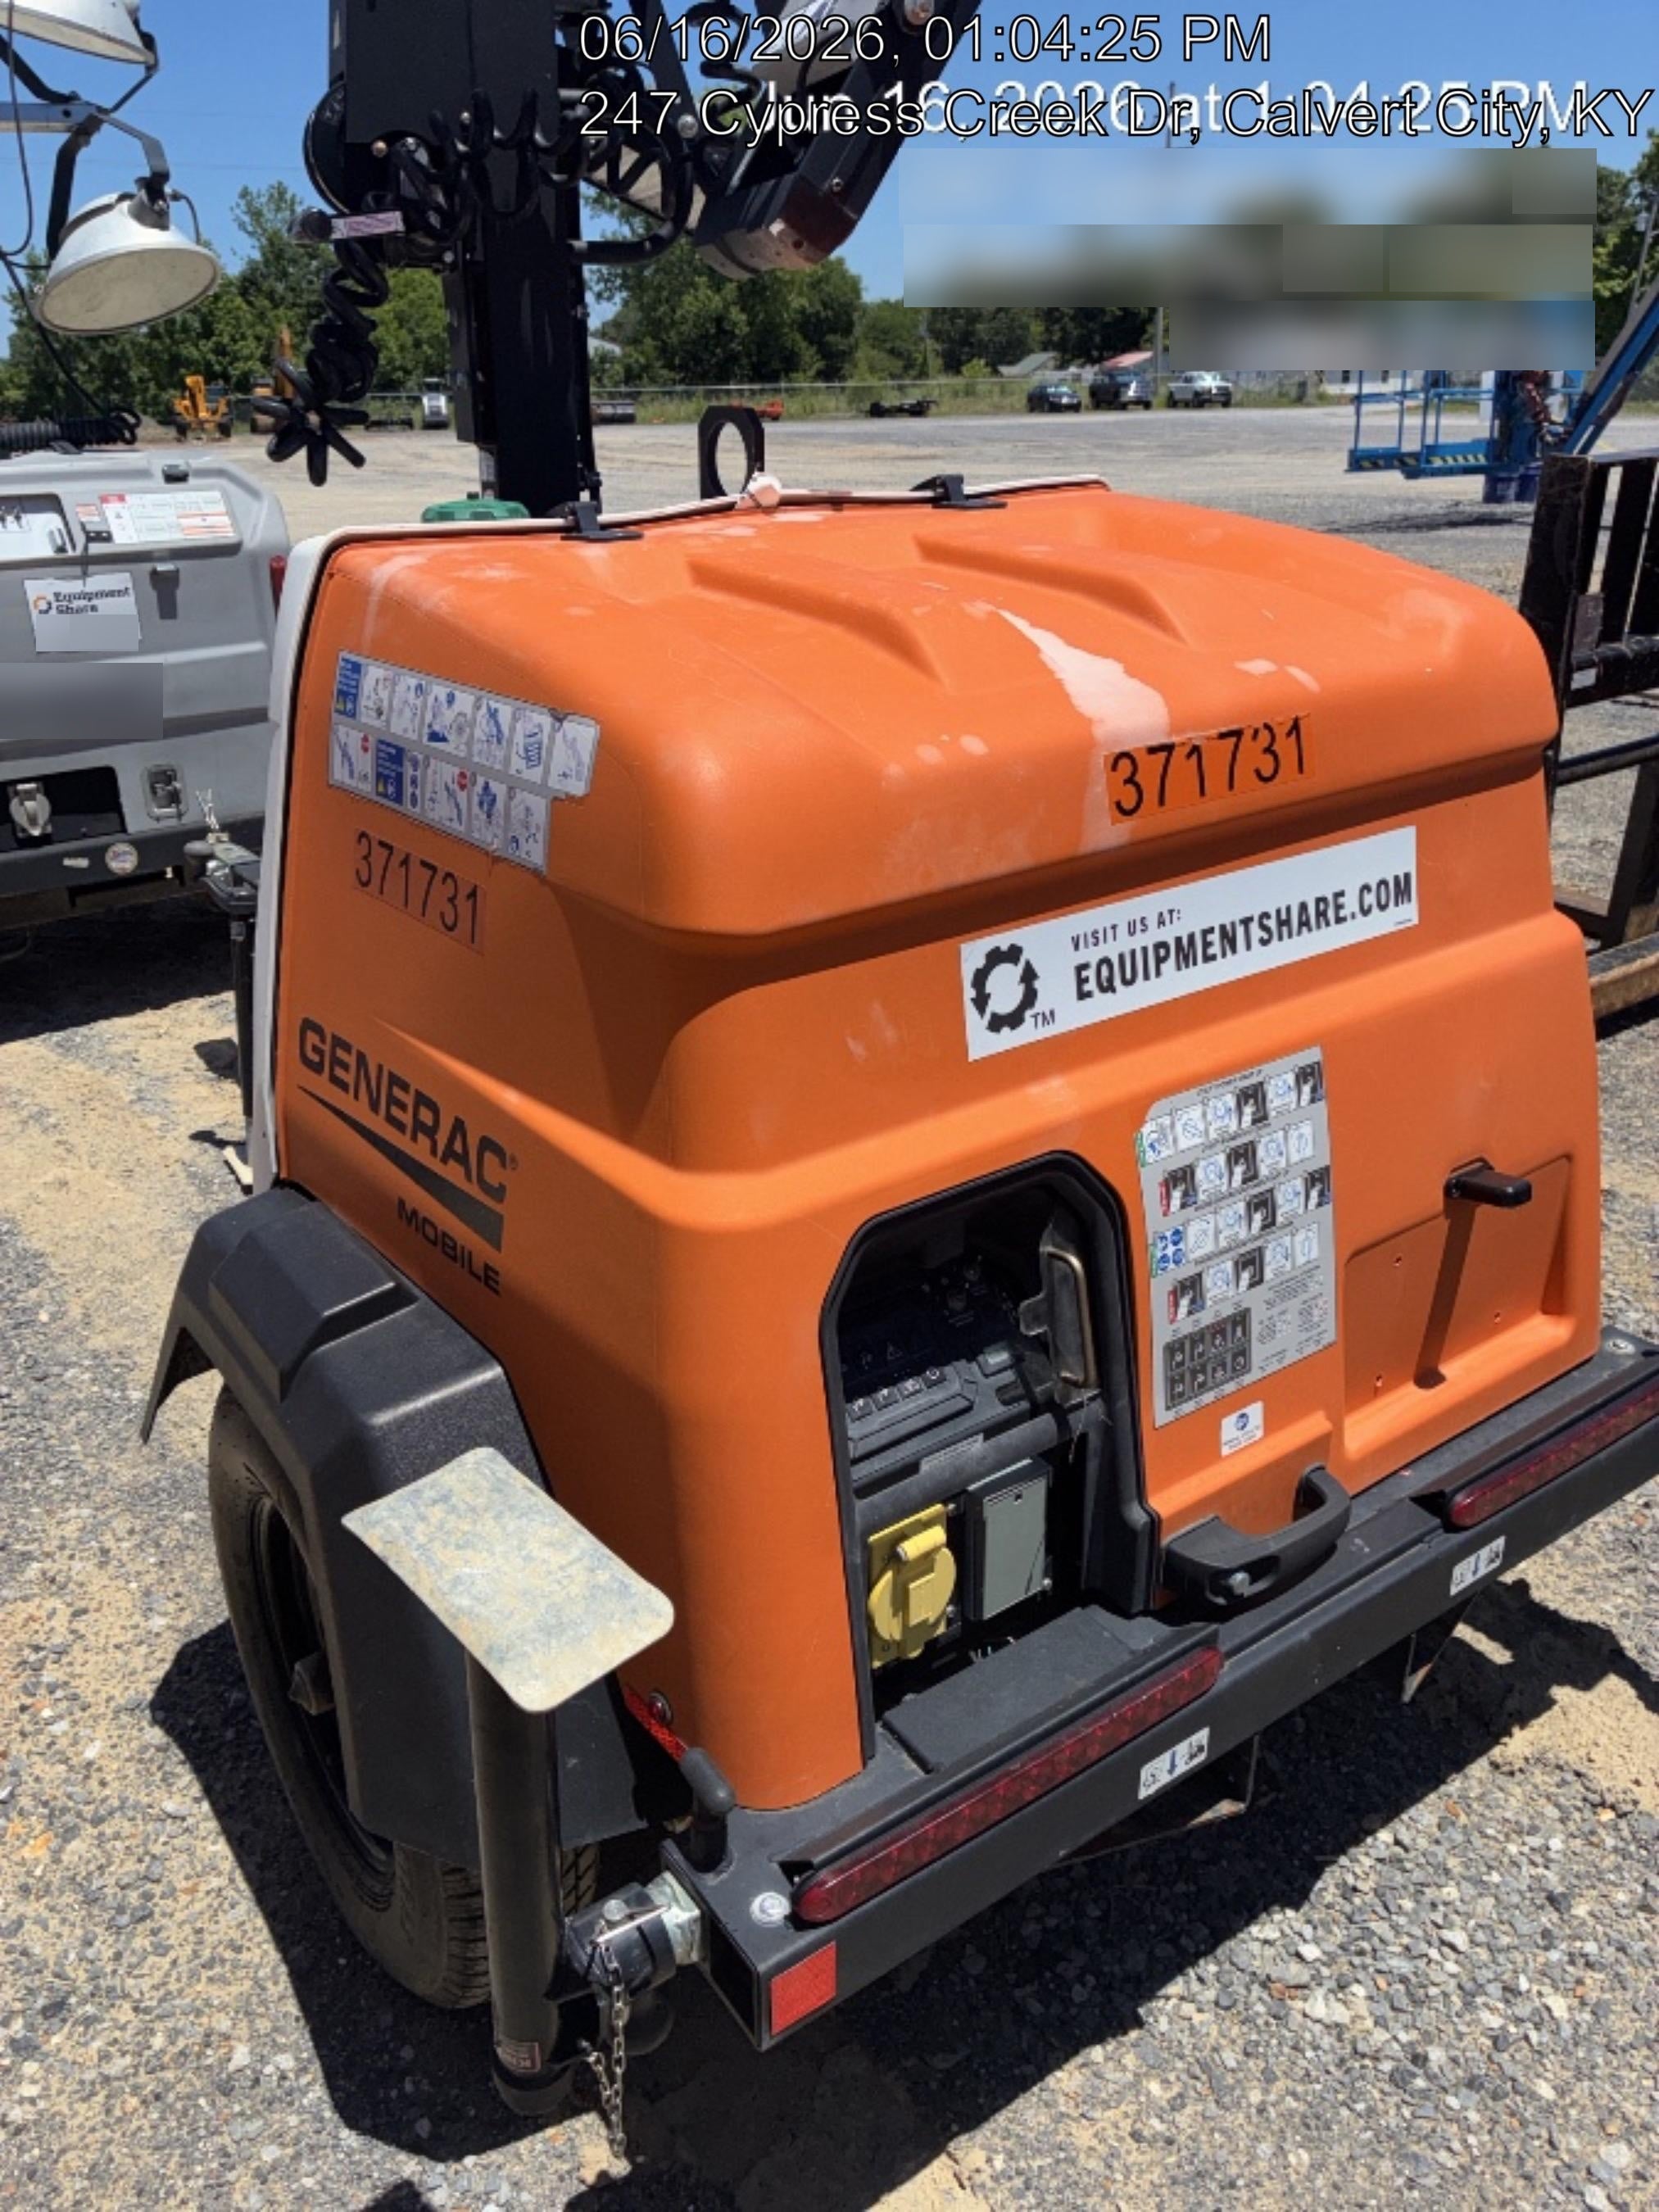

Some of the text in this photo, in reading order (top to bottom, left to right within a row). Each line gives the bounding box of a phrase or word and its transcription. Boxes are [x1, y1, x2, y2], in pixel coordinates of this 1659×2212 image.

[1109, 714, 1307, 818] 371731
[354, 830, 480, 946] 371731
[1071, 909, 1181, 952] VISIT US AT:
[1073, 872, 1413, 1001] EQUIPMENTSHARE.COM
[1030, 1008, 1056, 1029] TM
[397, 1196, 502, 1298] MOBILE
